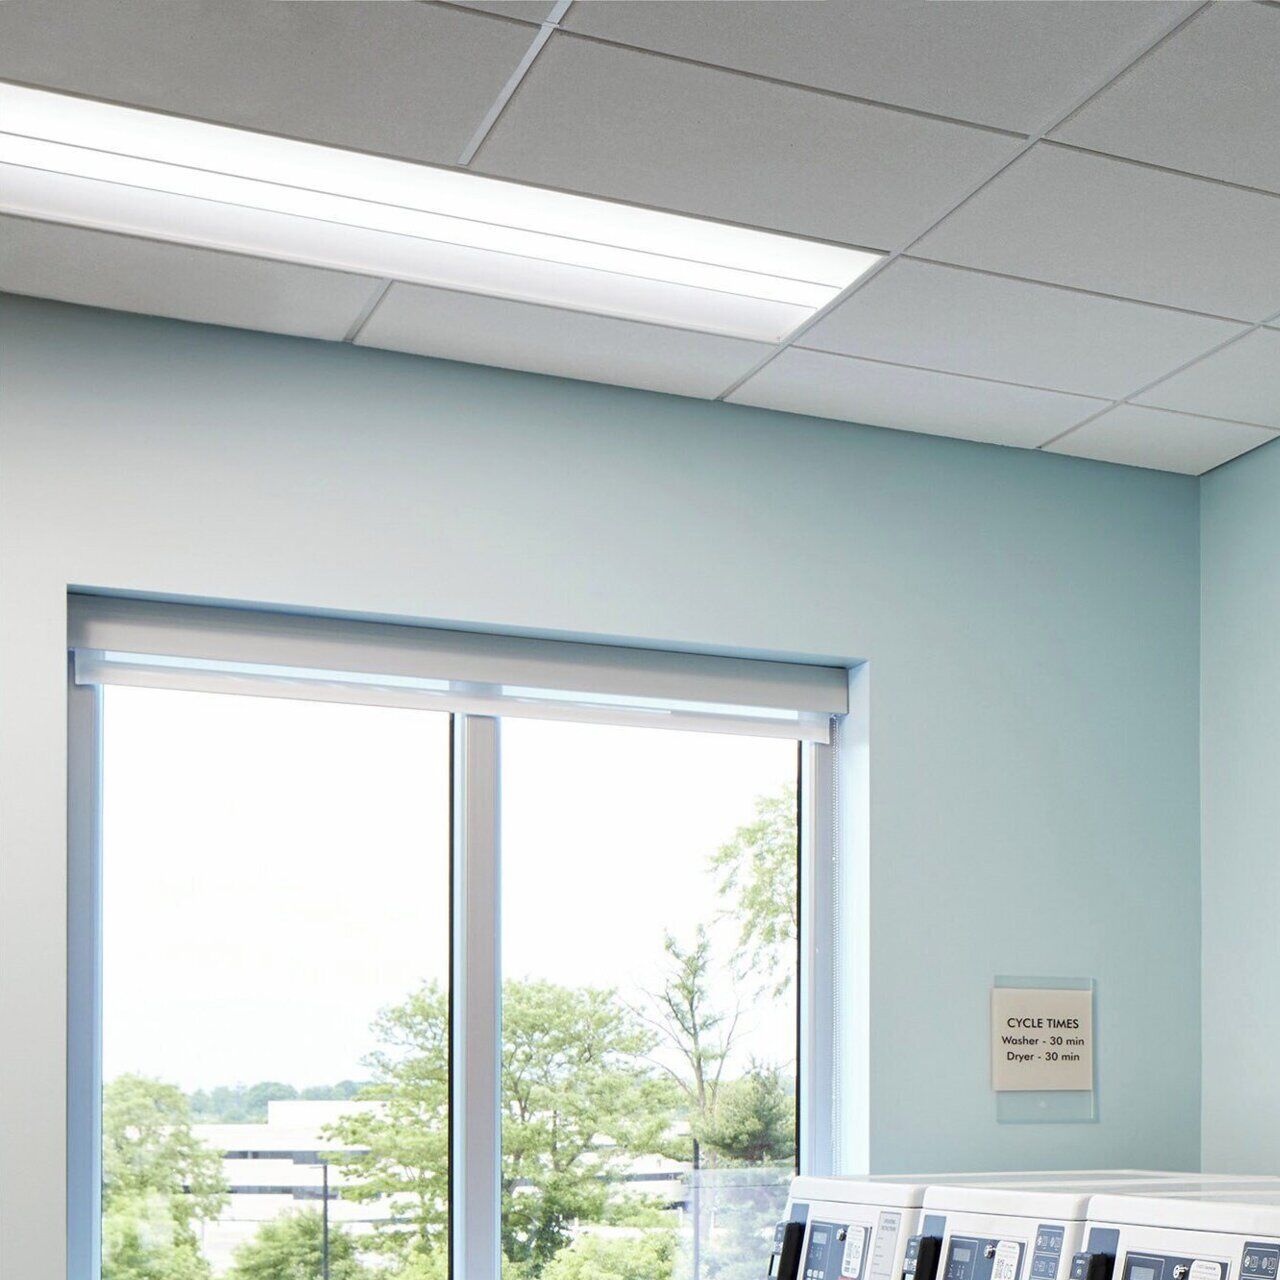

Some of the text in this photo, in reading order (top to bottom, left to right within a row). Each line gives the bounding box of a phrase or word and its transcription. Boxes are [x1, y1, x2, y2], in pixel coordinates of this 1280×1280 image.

[1007, 1018, 1079, 1028] CYCLE TIMES
[1002, 1036, 1038, 1045] Washer
[1050, 1037, 1062, 1045] 30
[1066, 1037, 1084, 1045] min
[1007, 1052, 1034, 1062] Dryer
[1045, 1052, 1058, 1061] 30
[1062, 1052, 1080, 1061] min
